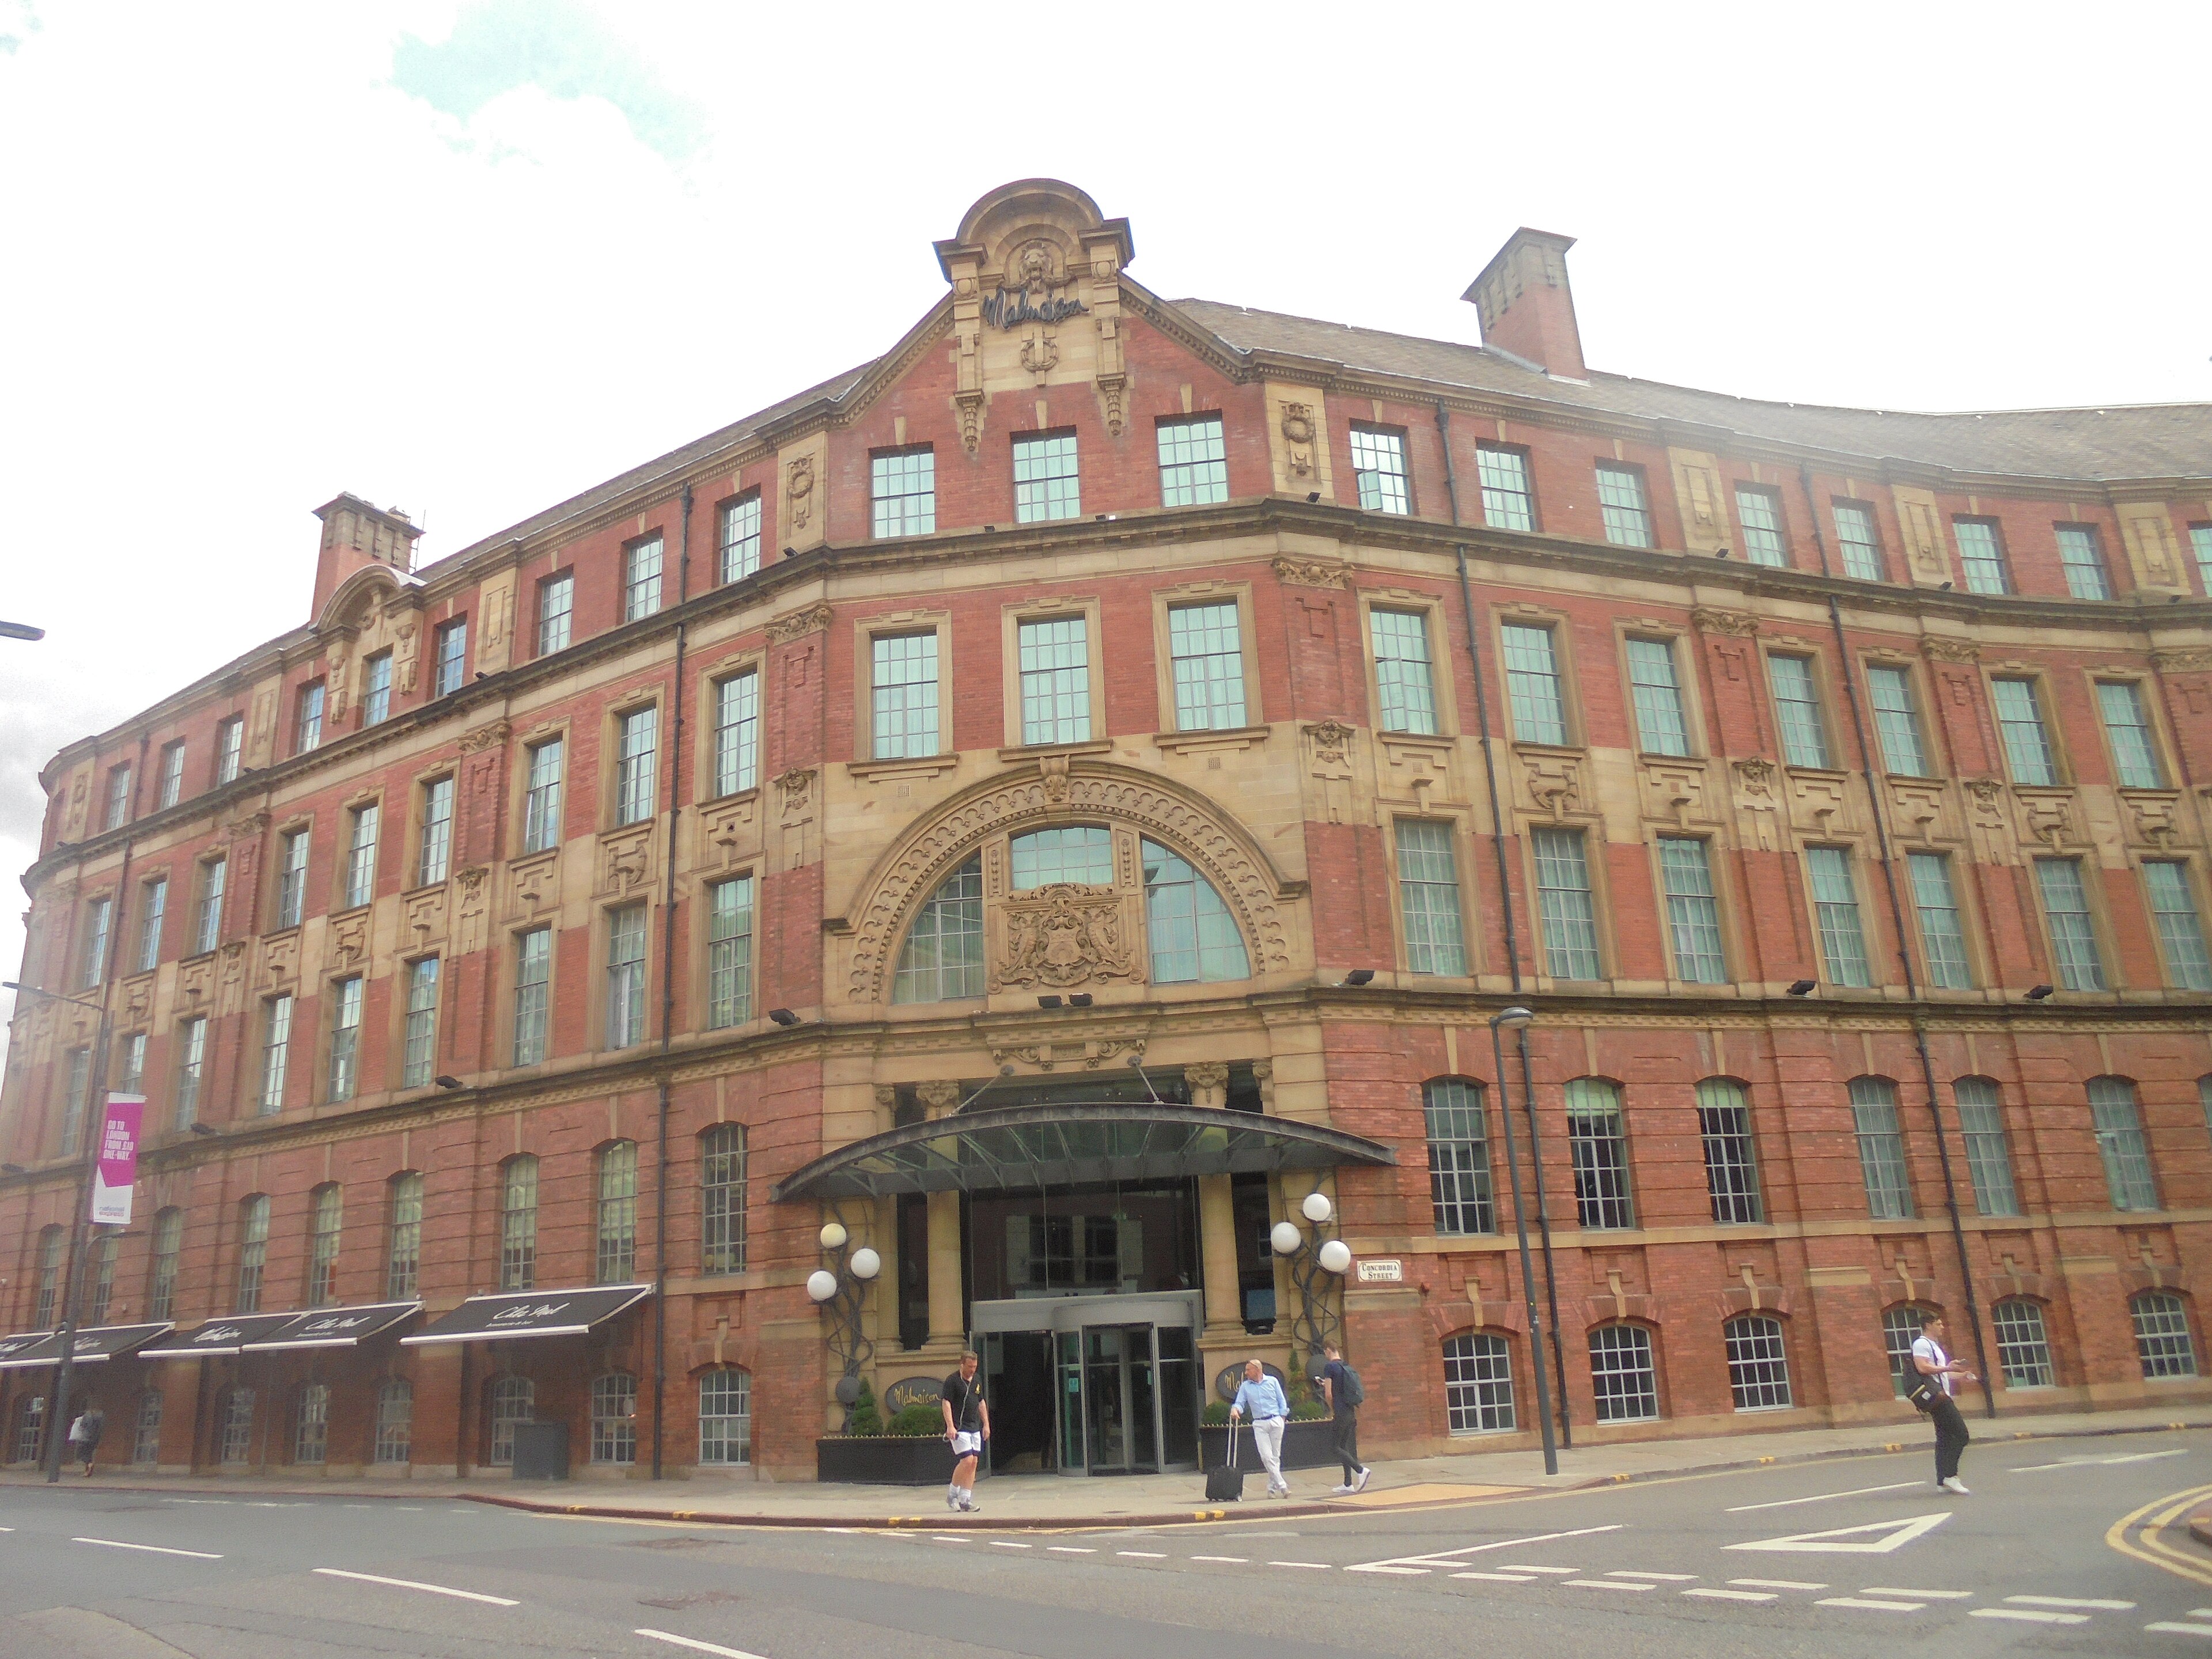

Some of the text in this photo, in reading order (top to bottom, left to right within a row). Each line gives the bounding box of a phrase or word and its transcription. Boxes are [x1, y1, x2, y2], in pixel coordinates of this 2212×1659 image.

[107, 1120, 125, 1131] GO TO
[106, 1130, 130, 1141] LONDON
[104, 1139, 122, 1150] FROM
[1368, 1271, 1393, 1279] STREET
[894, 1385, 942, 1406] Malmaison
